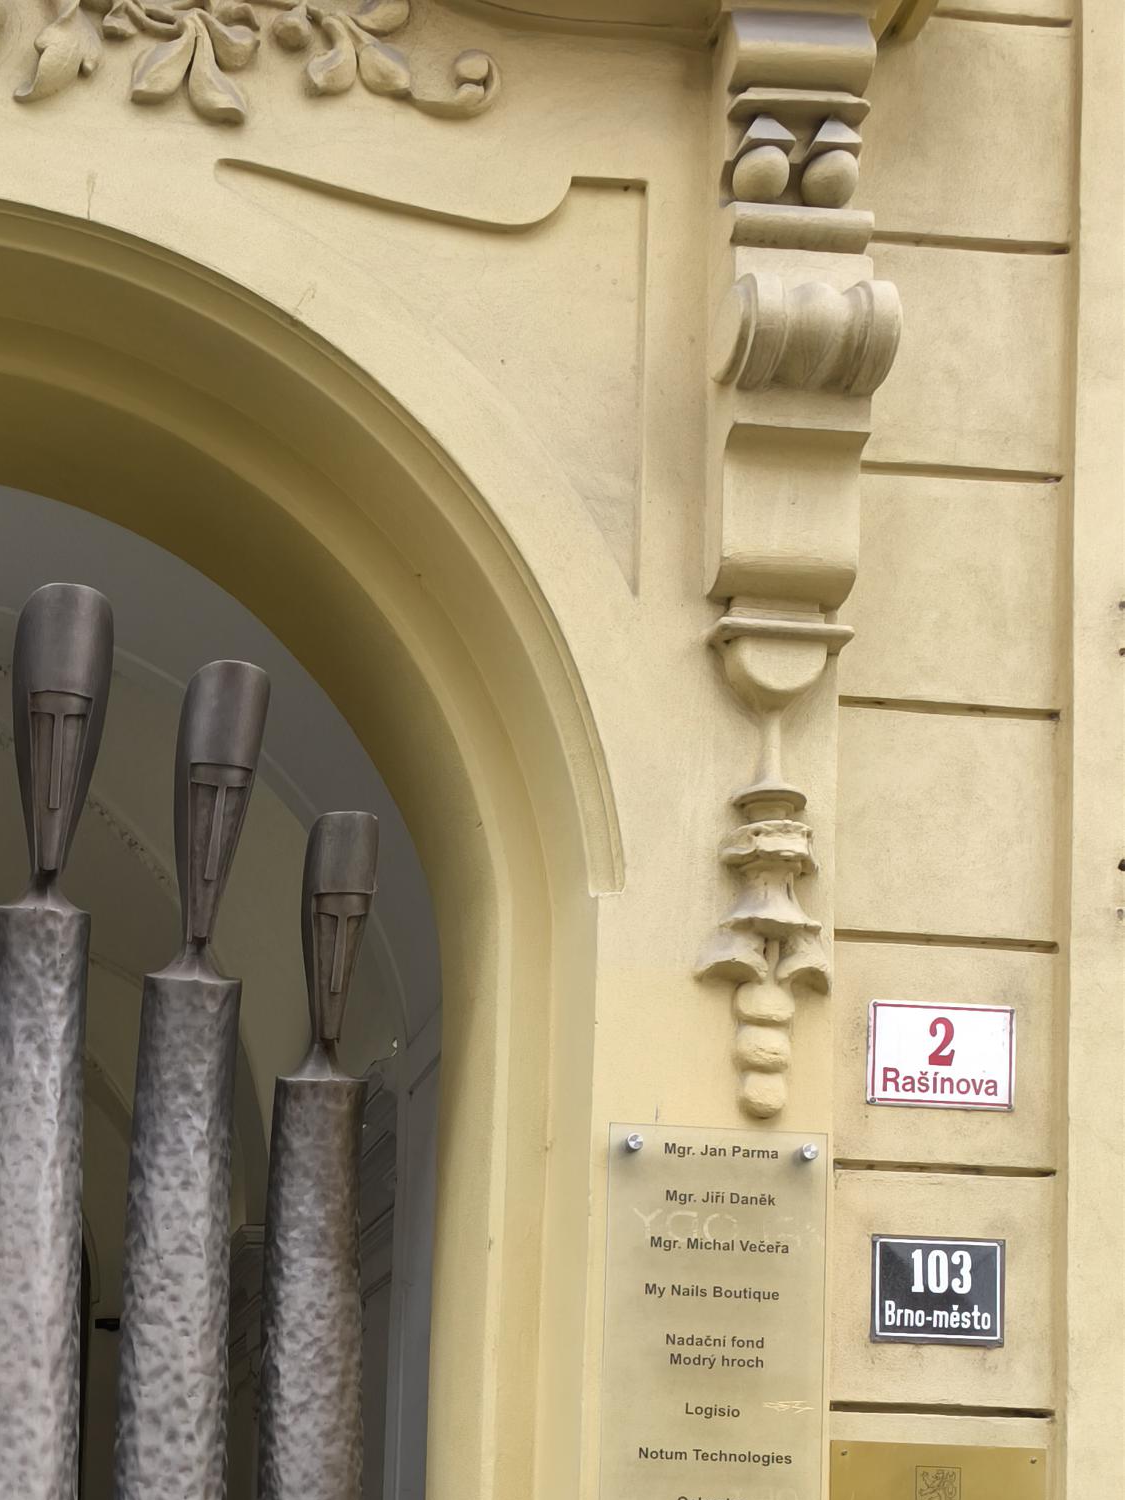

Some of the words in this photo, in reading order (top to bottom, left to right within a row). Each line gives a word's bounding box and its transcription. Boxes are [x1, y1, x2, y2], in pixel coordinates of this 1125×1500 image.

[929, 1017, 955, 1066] 2
[882, 1066, 998, 1097] Rašínova
[665, 1142, 695, 1158] Mgr.
[701, 1145, 726, 1156] Jan
[732, 1146, 778, 1159] Parma
[666, 1190, 696, 1205] Mgr.
[702, 1192, 725, 1204] Jiří
[730, 1193, 775, 1206] Daněk
[651, 1236, 681, 1251] Mgr.
[687, 1238, 734, 1251] Michal
[740, 1240, 789, 1254] Večeřa
[911, 1249, 972, 1294] 103
[645, 1283, 666, 1298] My
[671, 1284, 707, 1297] Nails
[713, 1286, 779, 1303] Boutique
[884, 1299, 991, 1329] Brno-město
[666, 1334, 726, 1347] Nadační
[731, 1336, 764, 1349] fond
[670, 1353, 716, 1369] Modrý
[722, 1355, 763, 1368] hroch
[685, 1403, 740, 1419] Logisio
[639, 1447, 687, 1460] Notum
[693, 1449, 792, 1466] Technologies
